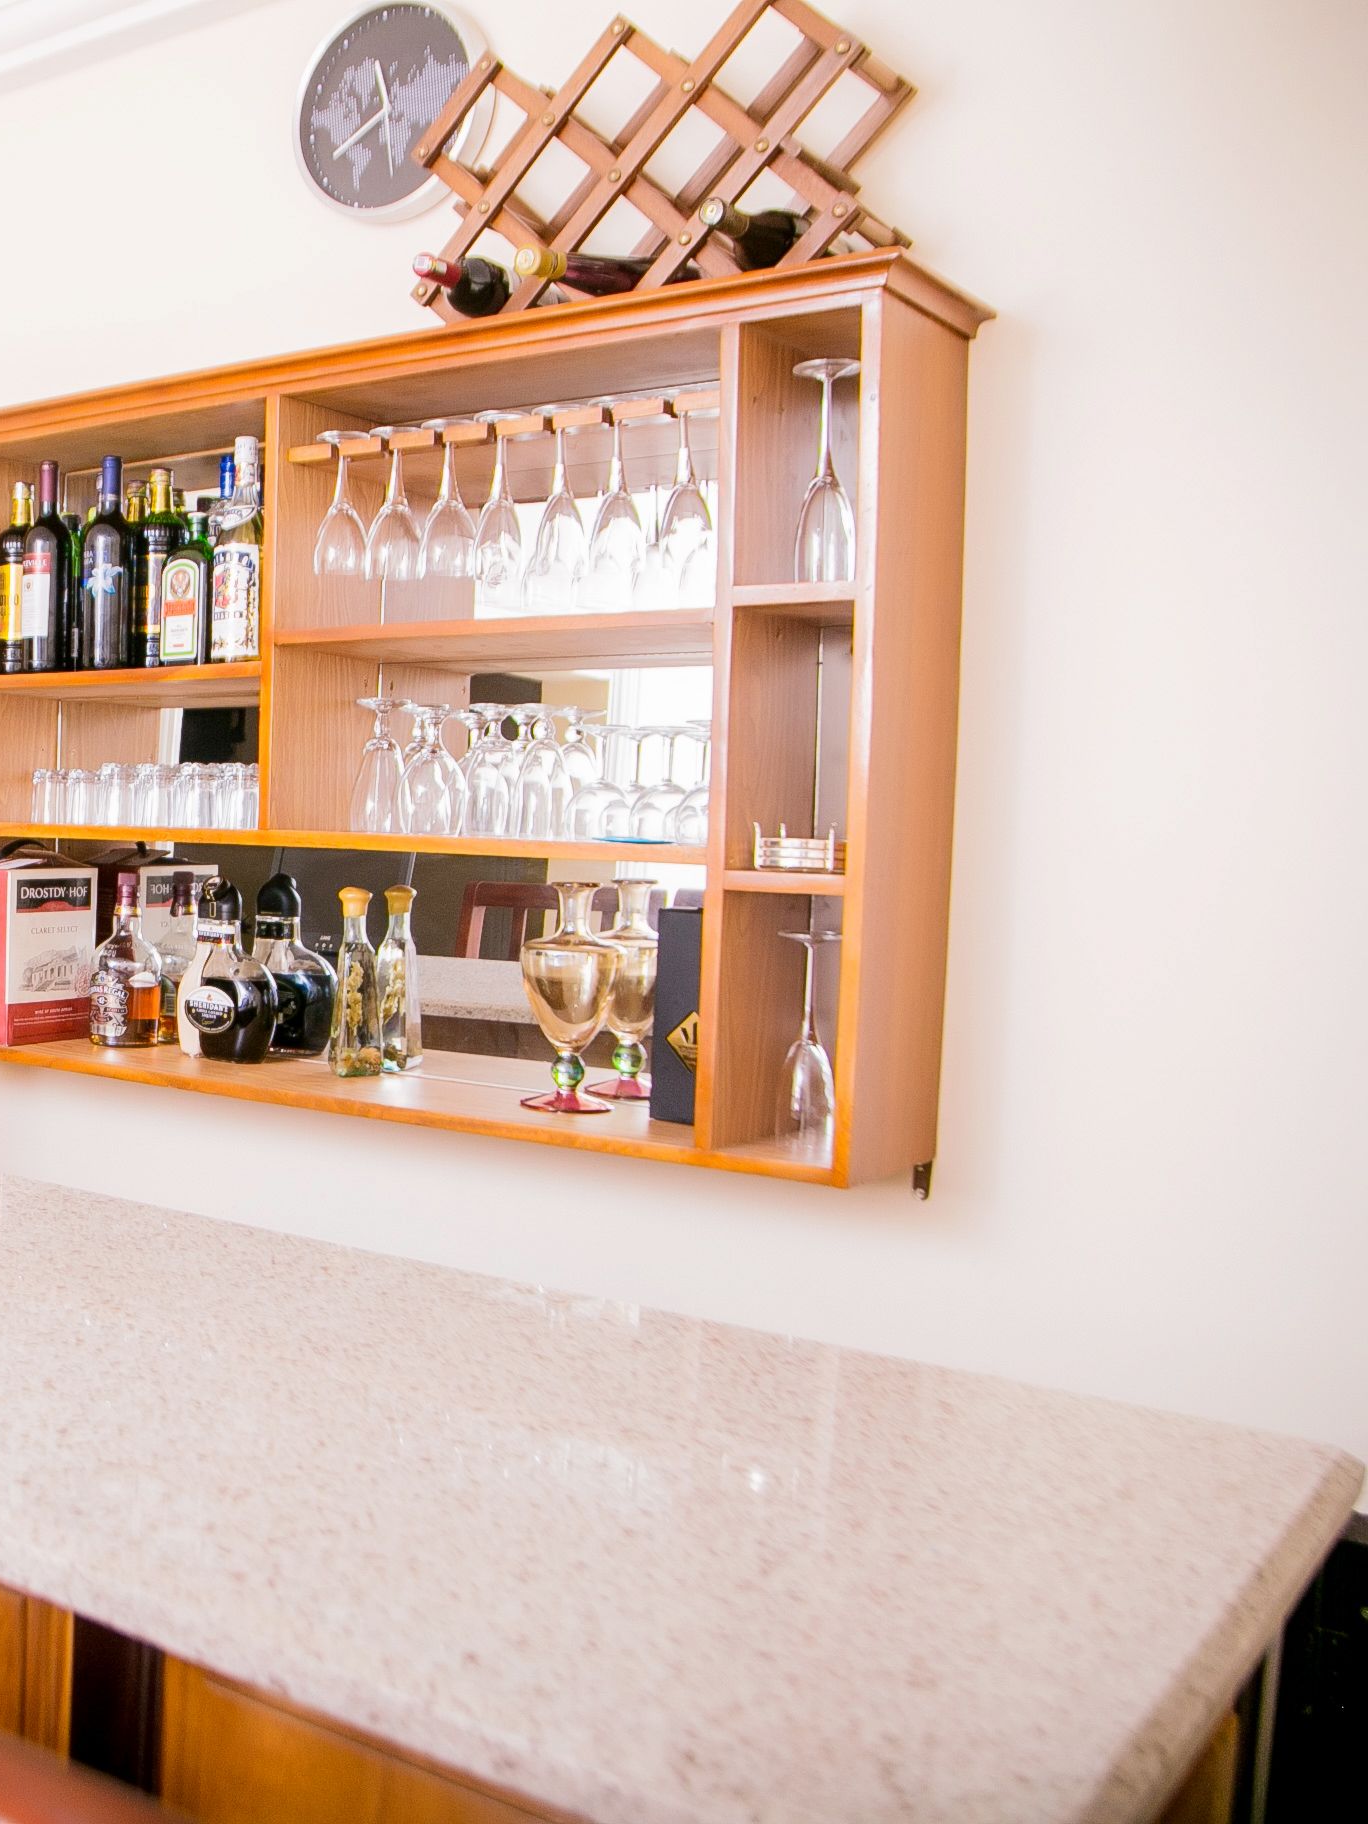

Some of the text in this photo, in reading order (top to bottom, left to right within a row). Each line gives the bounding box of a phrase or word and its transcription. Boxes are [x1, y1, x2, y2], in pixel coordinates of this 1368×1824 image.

[30, 927, 55, 935] CLARET
[104, 985, 126, 998] REGAL
[189, 999, 229, 1013] SHERIDAN'S
